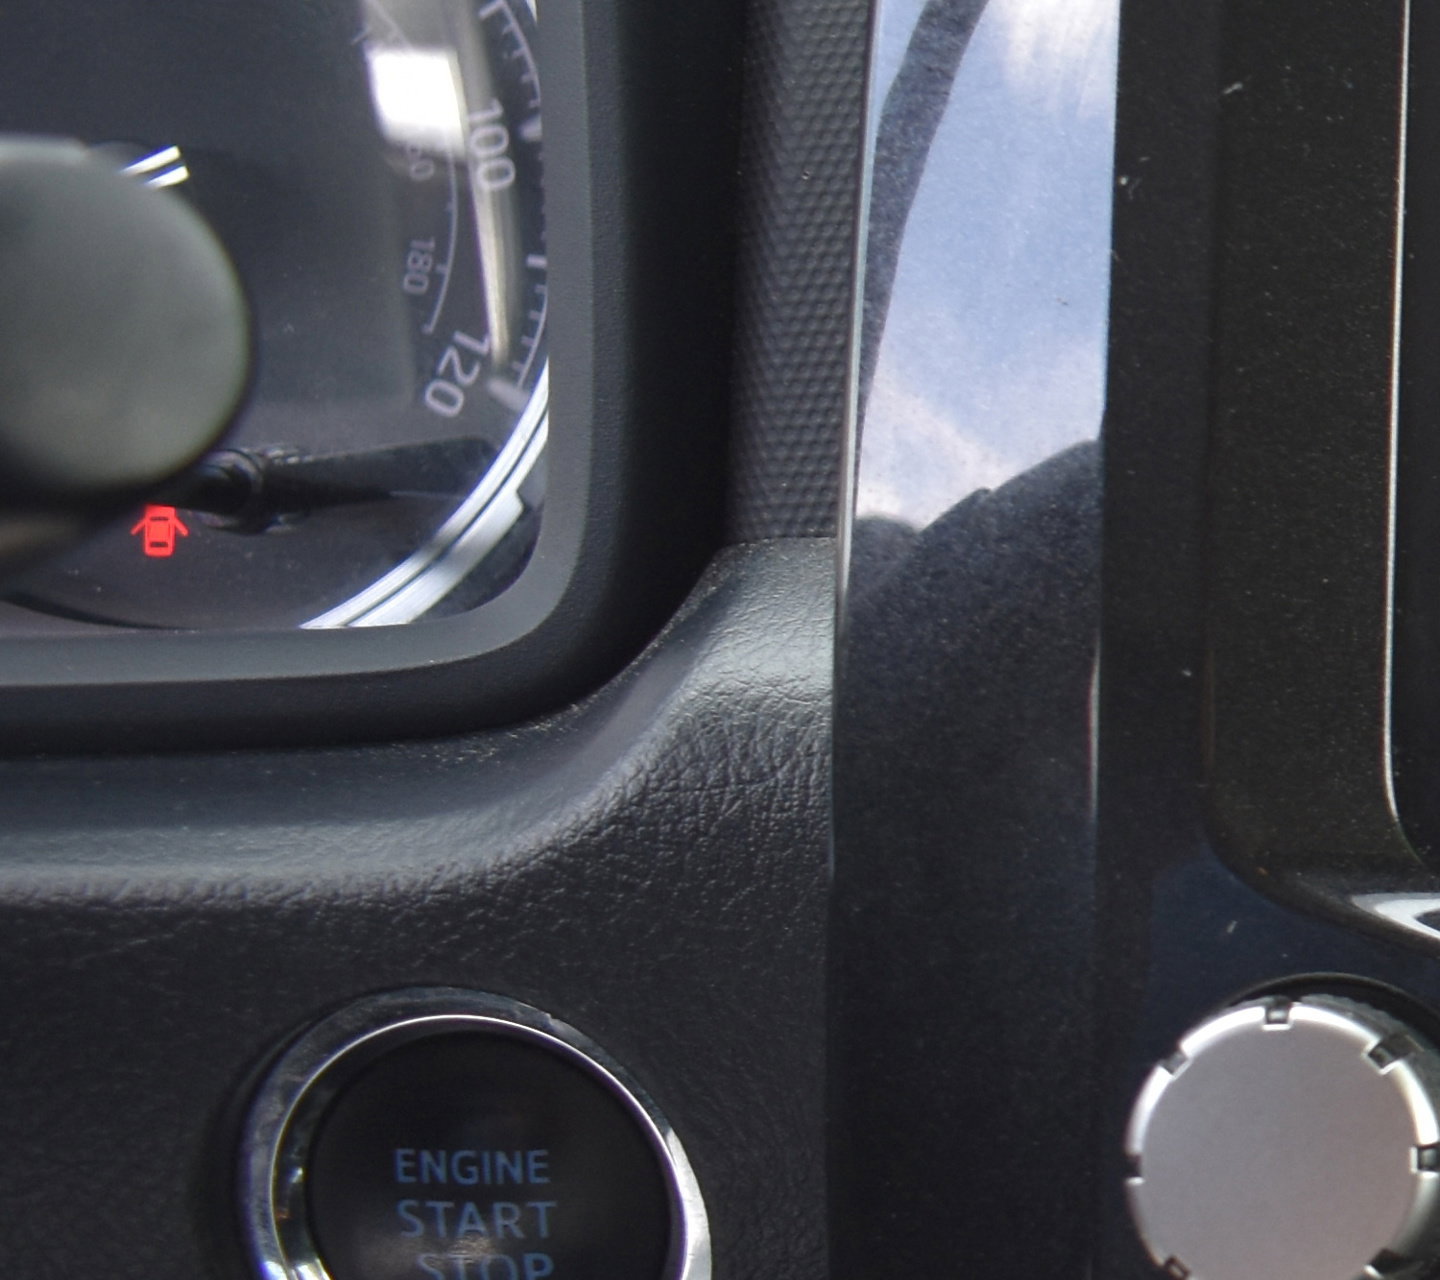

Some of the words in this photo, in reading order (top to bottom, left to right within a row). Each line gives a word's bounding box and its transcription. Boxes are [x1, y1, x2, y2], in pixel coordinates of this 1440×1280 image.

[468, 98, 516, 192] 100
[403, 236, 437, 295] 180
[423, 329, 491, 418] 120
[393, 1147, 550, 1186] ENGINE
[396, 1199, 558, 1240] START
